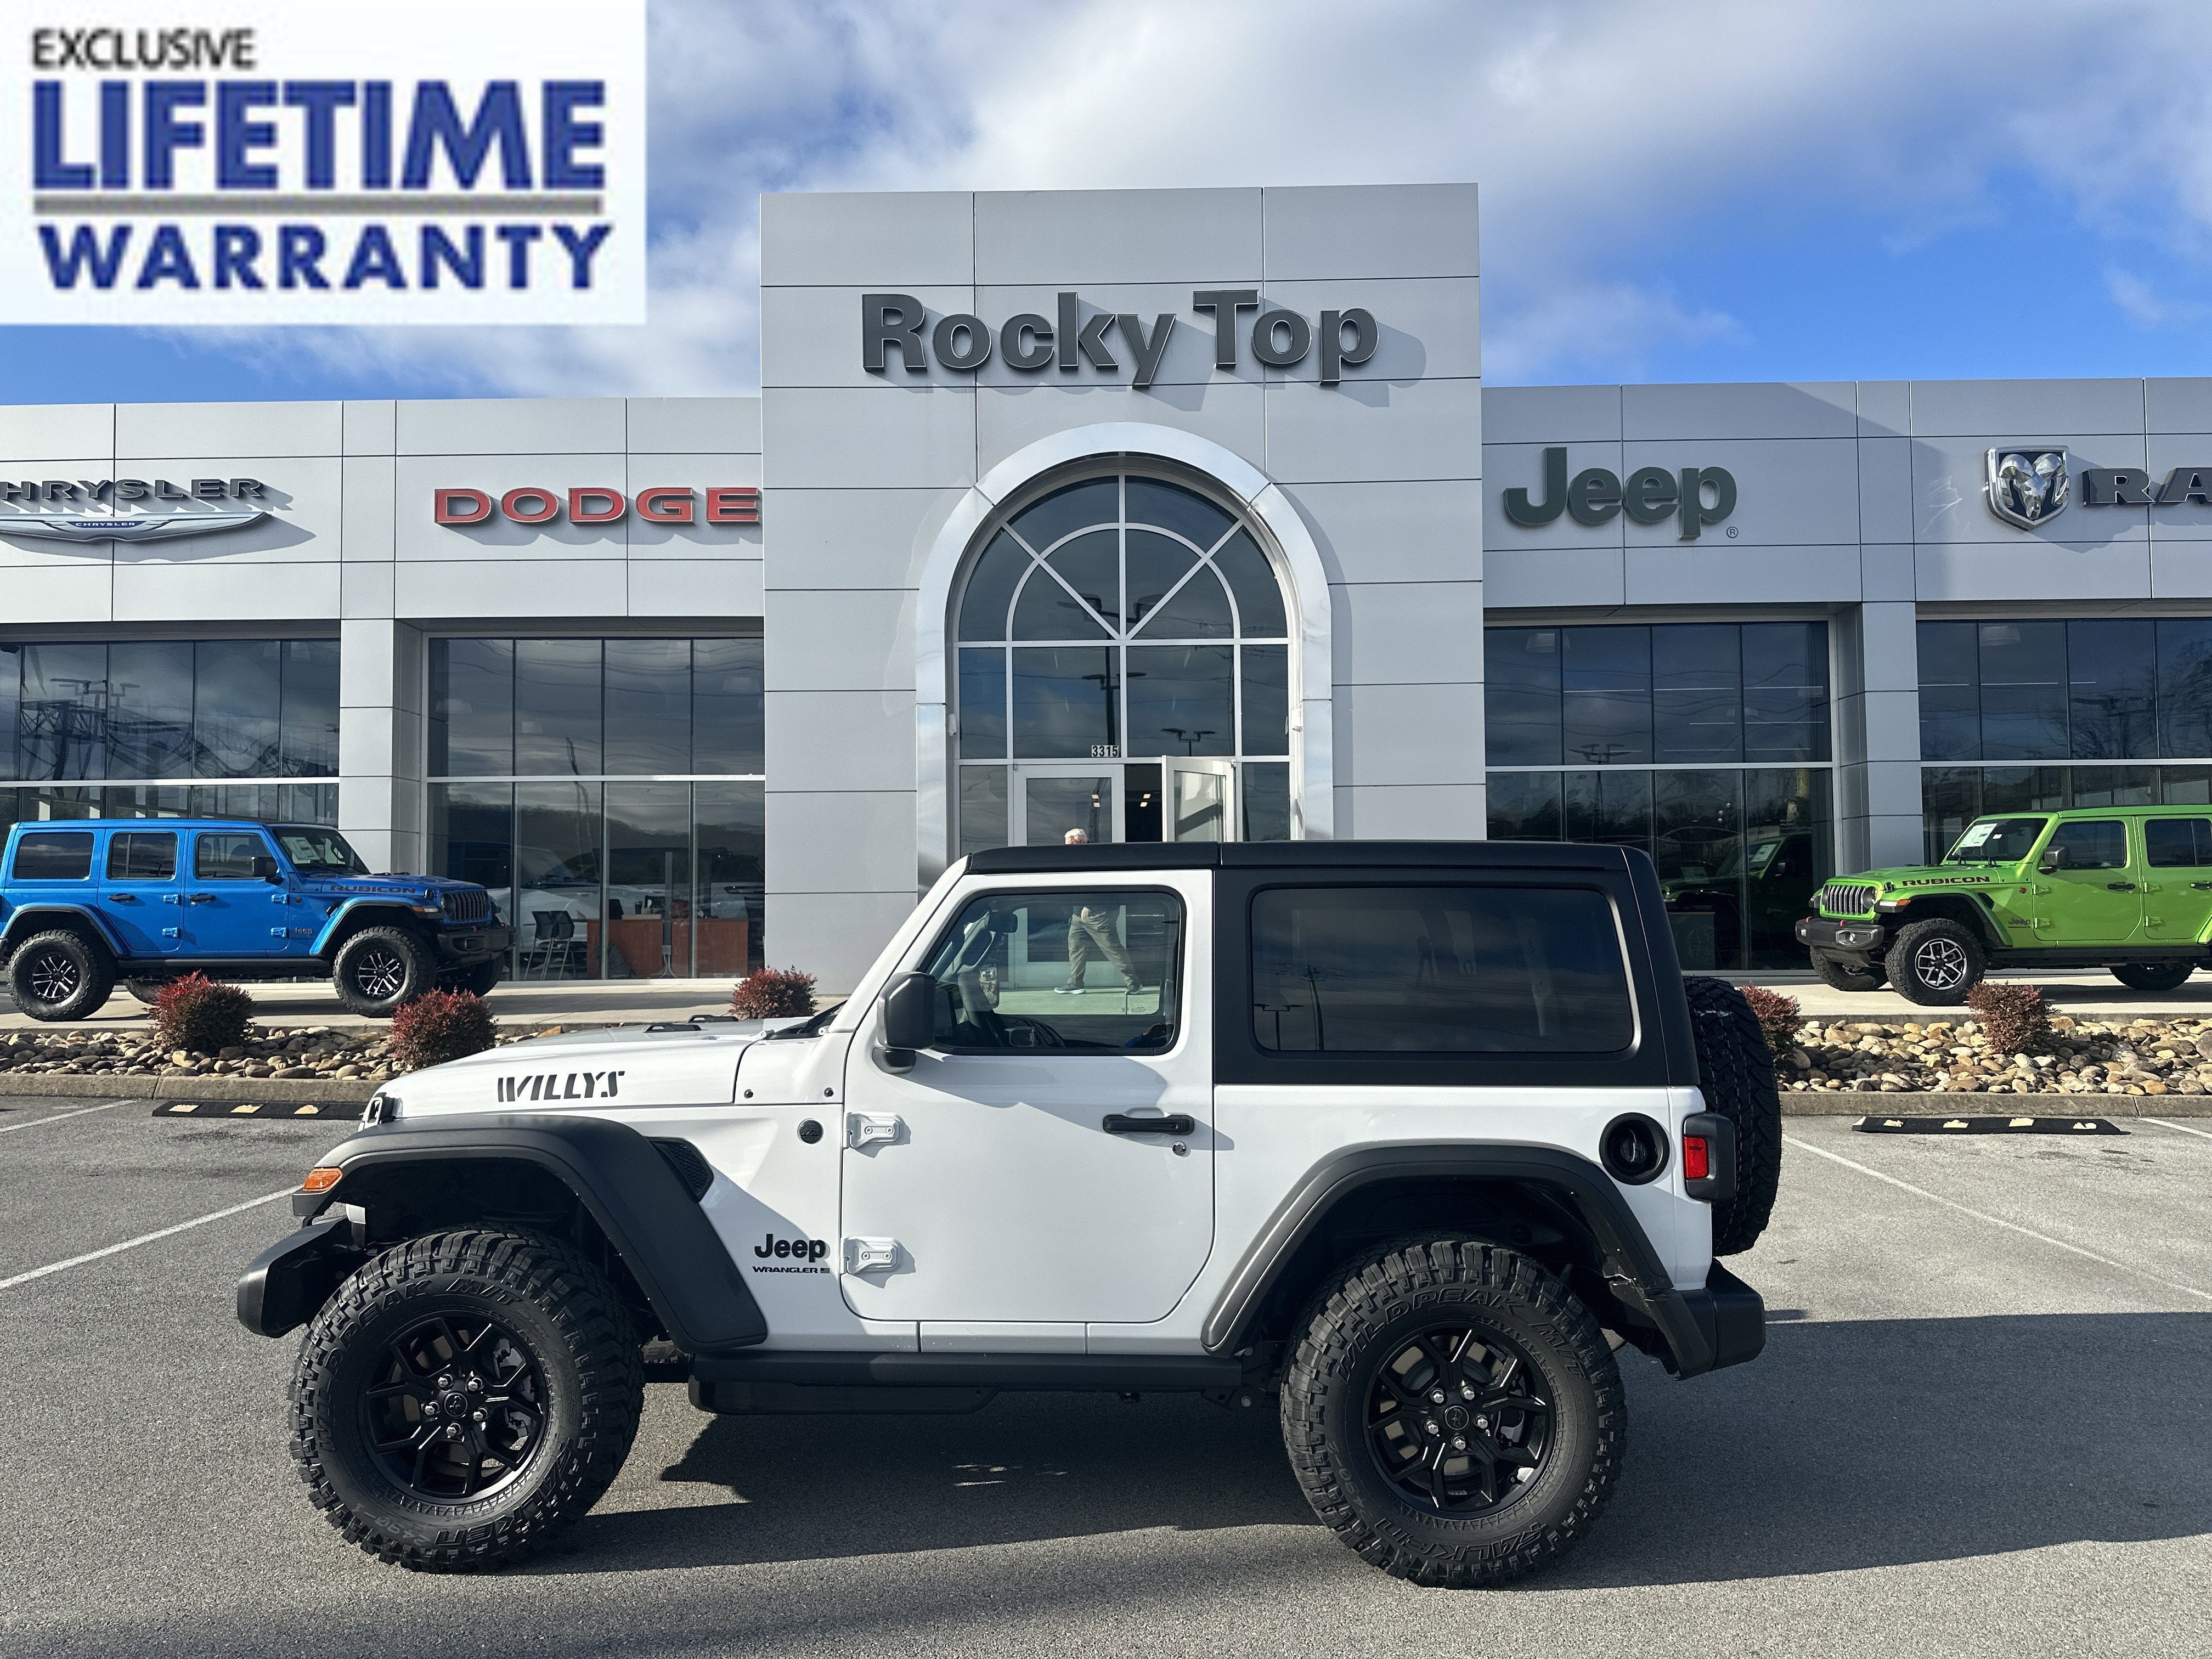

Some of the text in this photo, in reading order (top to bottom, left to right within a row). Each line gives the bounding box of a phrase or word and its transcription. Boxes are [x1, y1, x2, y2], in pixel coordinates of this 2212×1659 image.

[862, 289, 1379, 390] Rocky Top
[0, 478, 262, 500] HRYSLER
[1503, 447, 1737, 540] Jeep
[2083, 467, 2212, 506] RA
[434, 487, 761, 525] DODGE
[1092, 746, 1118, 757] 3315
[330, 885, 416, 894] RUBICON
[1902, 876, 1990, 886] RUBICON
[498, 1071, 625, 1102] WILLYS
[754, 1233, 826, 1262] Jeep
[1335, 1286, 1523, 1384] WILDPEAK
